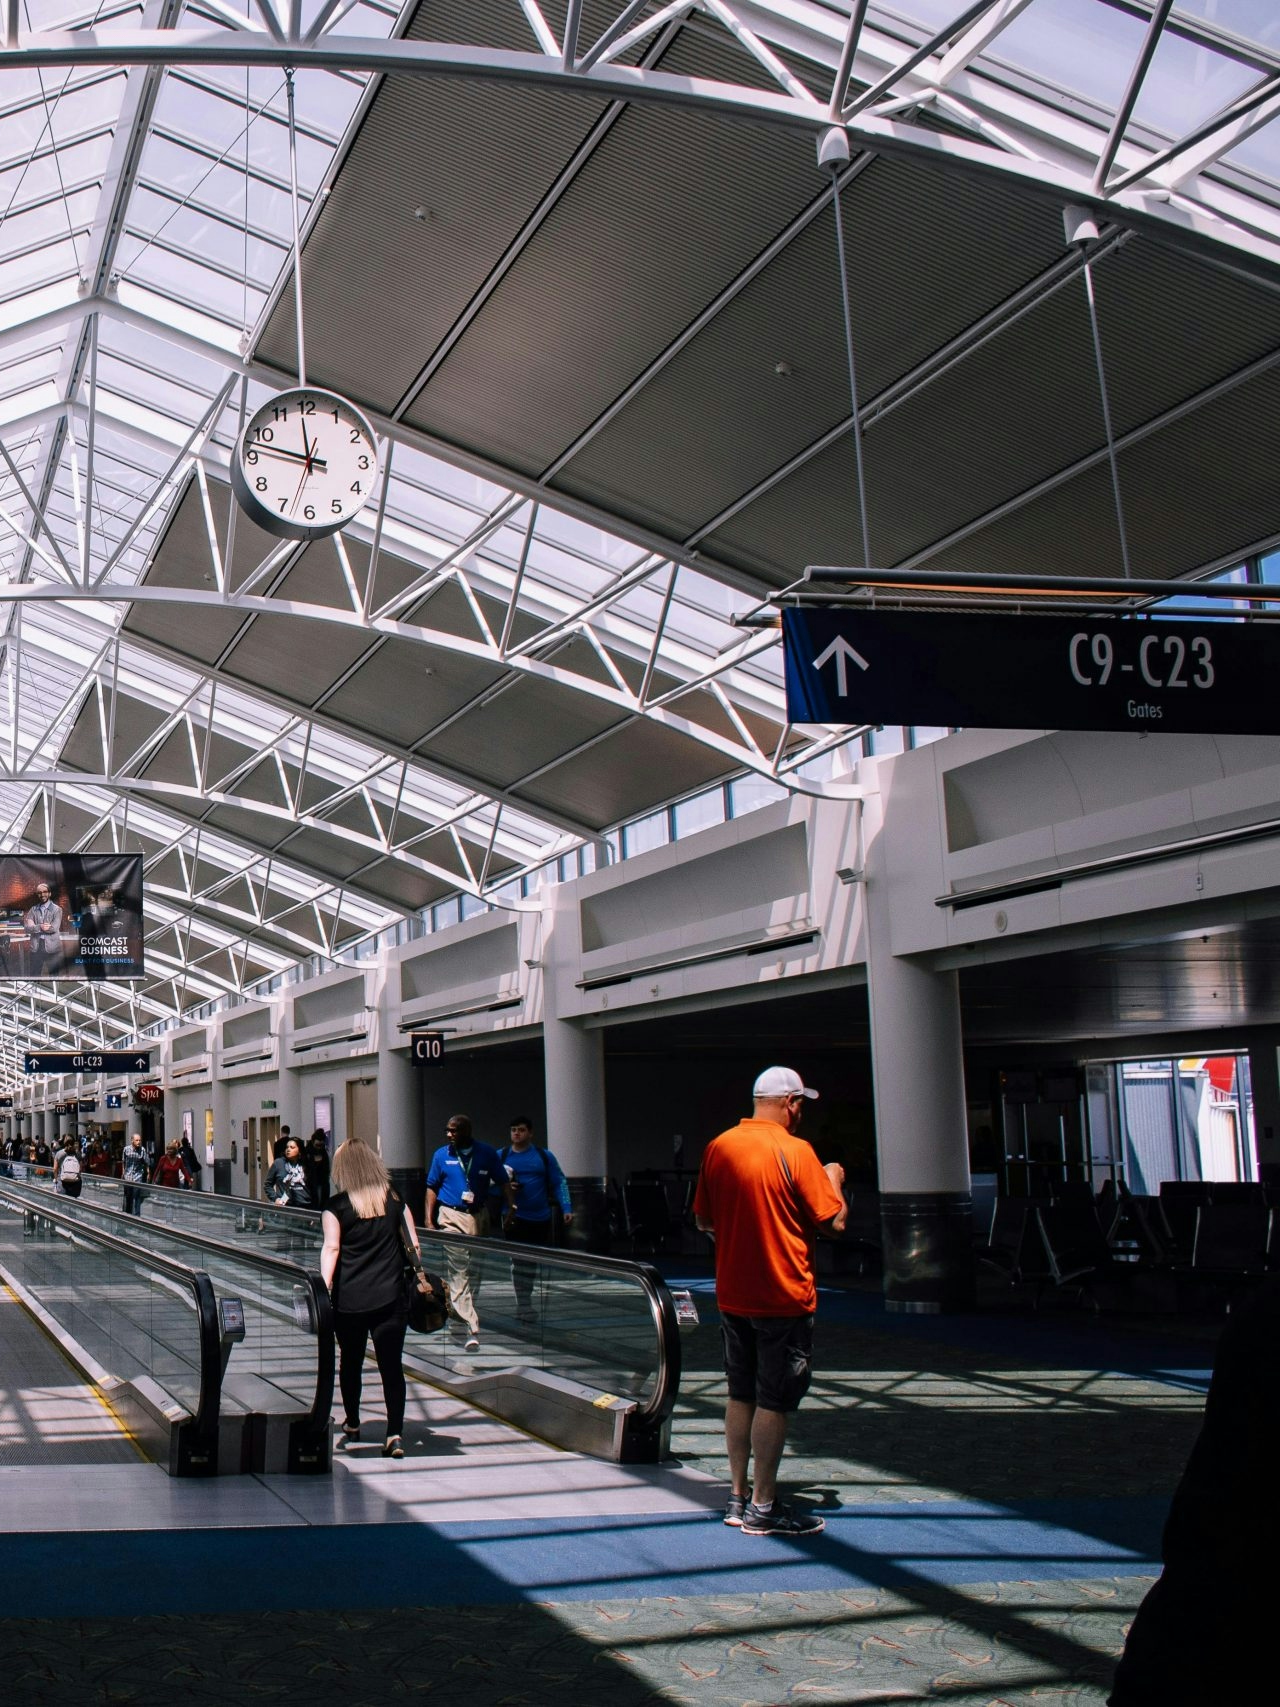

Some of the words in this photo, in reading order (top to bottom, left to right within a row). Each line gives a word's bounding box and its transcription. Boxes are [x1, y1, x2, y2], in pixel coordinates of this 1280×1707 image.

[272, 407, 287, 422] 11
[297, 401, 316, 415] 12
[331, 410, 339, 424] 1
[253, 427, 274, 442] 10
[350, 430, 361, 444] 2
[246, 451, 259, 465] 9
[358, 455, 369, 470] 3
[255, 476, 268, 491] 8
[350, 480, 362, 495] 4
[277, 498, 288, 512] 7
[304, 505, 316, 520] 6
[331, 499, 342, 514] 5
[1069, 633, 1215, 689] C9-C23
[1127, 700, 1163, 718] Gates
[80, 937, 128, 946] COMCAST
[80, 946, 129, 955] BUSINESS
[416, 1040, 441, 1058] C10
[72, 1056, 102, 1067] C11-C23
[140, 1088, 159, 1102] Spa
